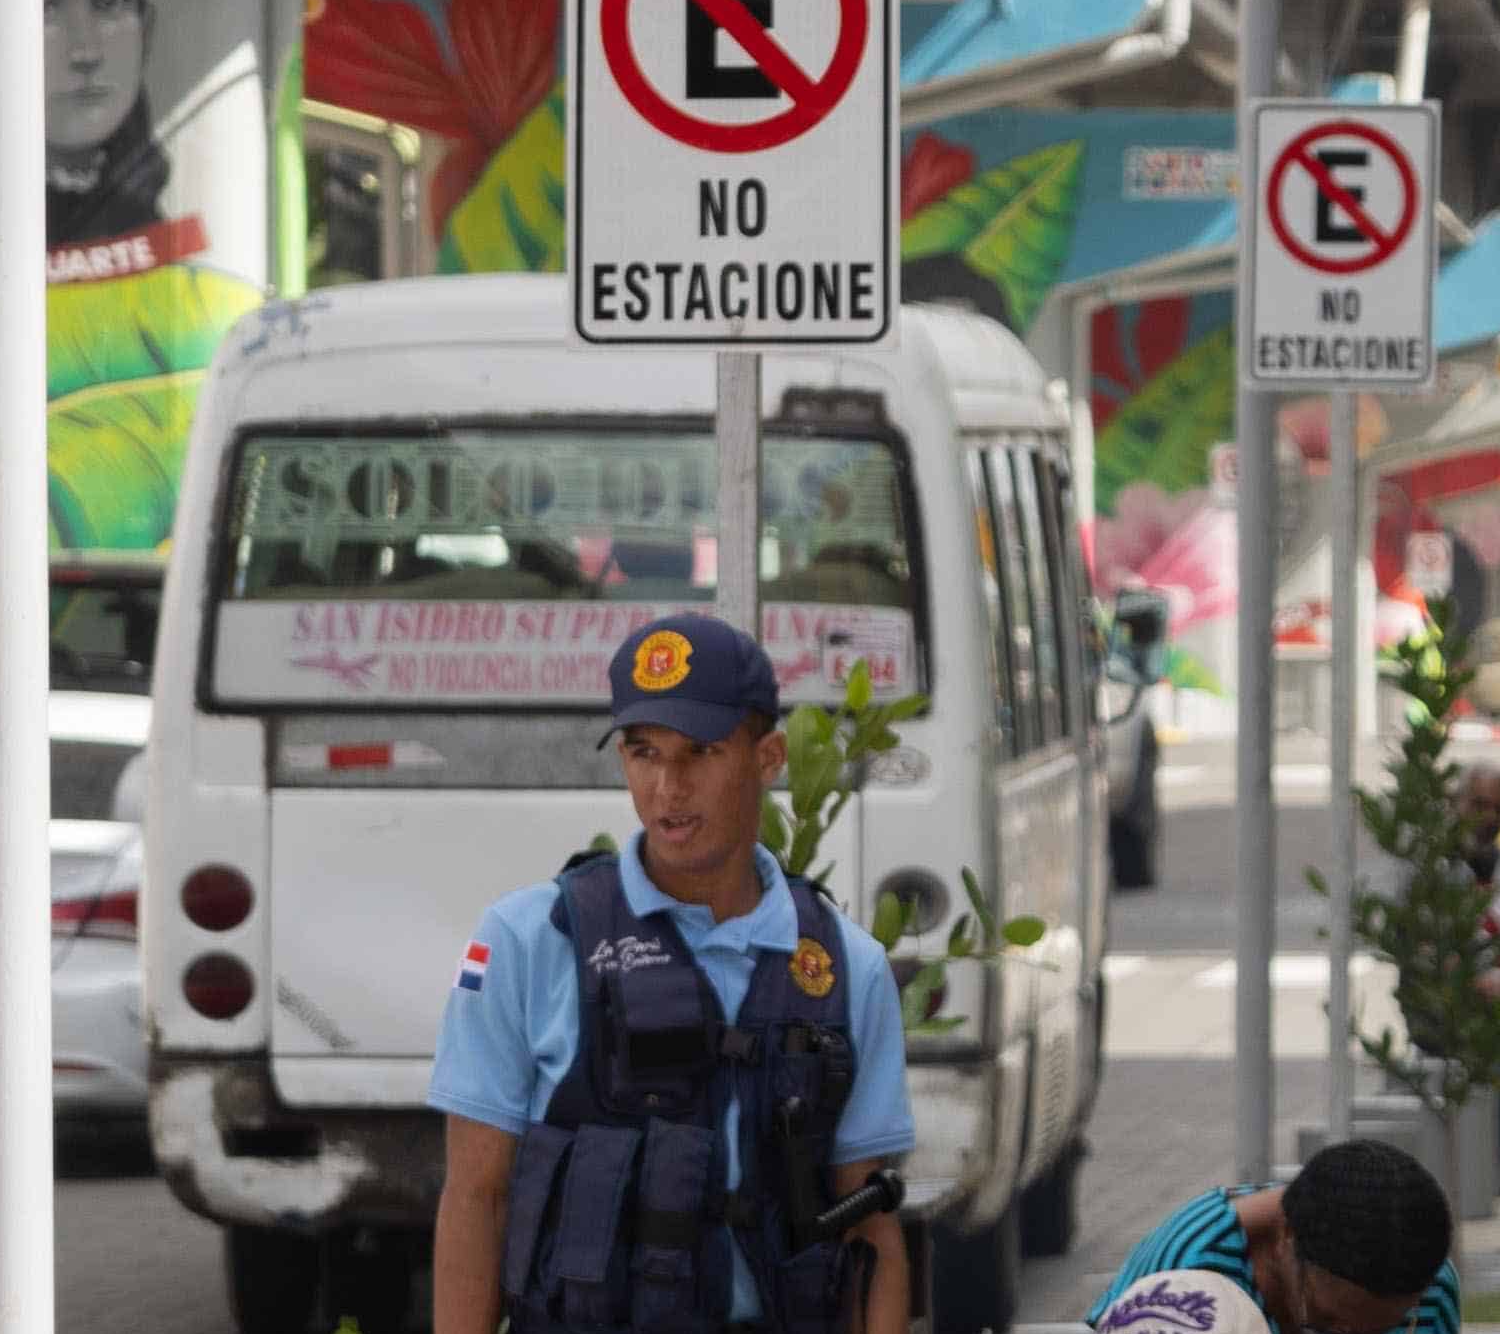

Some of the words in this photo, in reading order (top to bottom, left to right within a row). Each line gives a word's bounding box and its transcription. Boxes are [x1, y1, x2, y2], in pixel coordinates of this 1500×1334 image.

[698, 178, 768, 238] NO
[1315, 150, 1369, 243] E
[593, 261, 875, 322] ESTACIONE
[1319, 289, 1362, 324] NO
[1258, 335, 1422, 372] ESTACIONE
[280, 459, 557, 519] SOLO
[291, 602, 365, 642] SAN
[374, 602, 508, 642] ISIDRO
[386, 650, 418, 692] NO
[423, 650, 534, 693] VIOLENCIA
